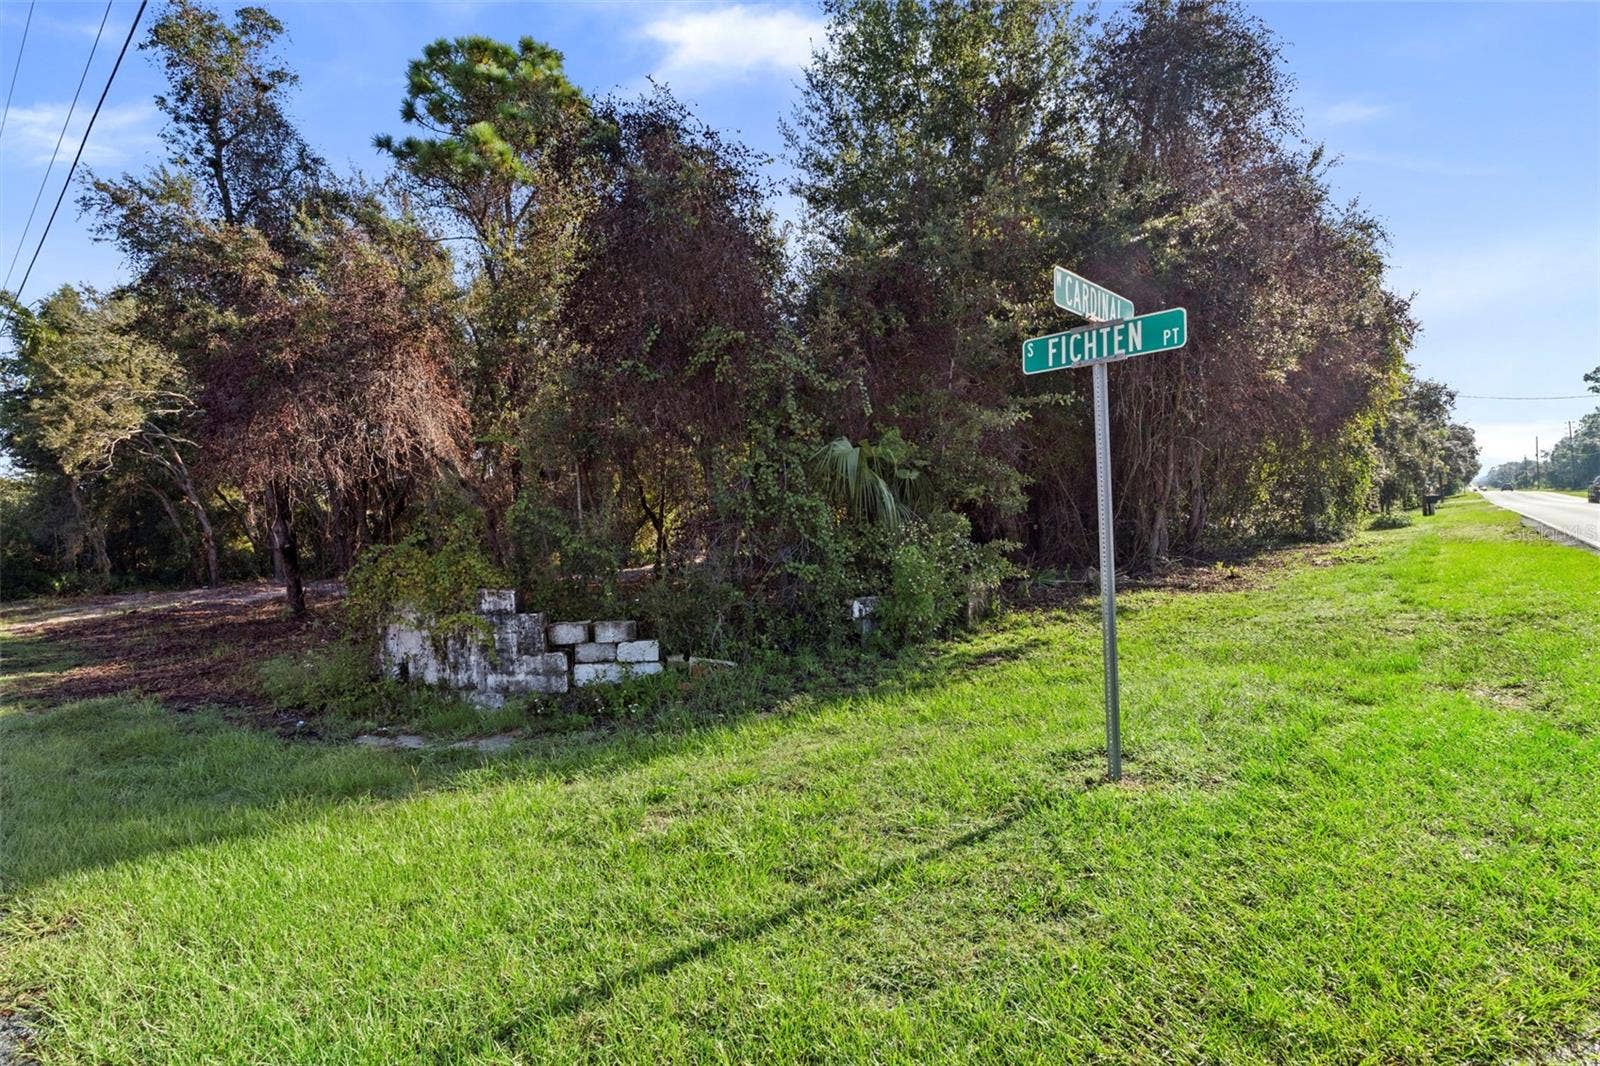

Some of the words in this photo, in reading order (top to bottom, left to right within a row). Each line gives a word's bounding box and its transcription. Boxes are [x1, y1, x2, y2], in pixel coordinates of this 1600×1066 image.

[1065, 275, 1121, 320] CARDINAL
[1027, 342, 1034, 358] S
[1048, 320, 1142, 367] FICHTEN
[1163, 327, 1180, 346] PT
